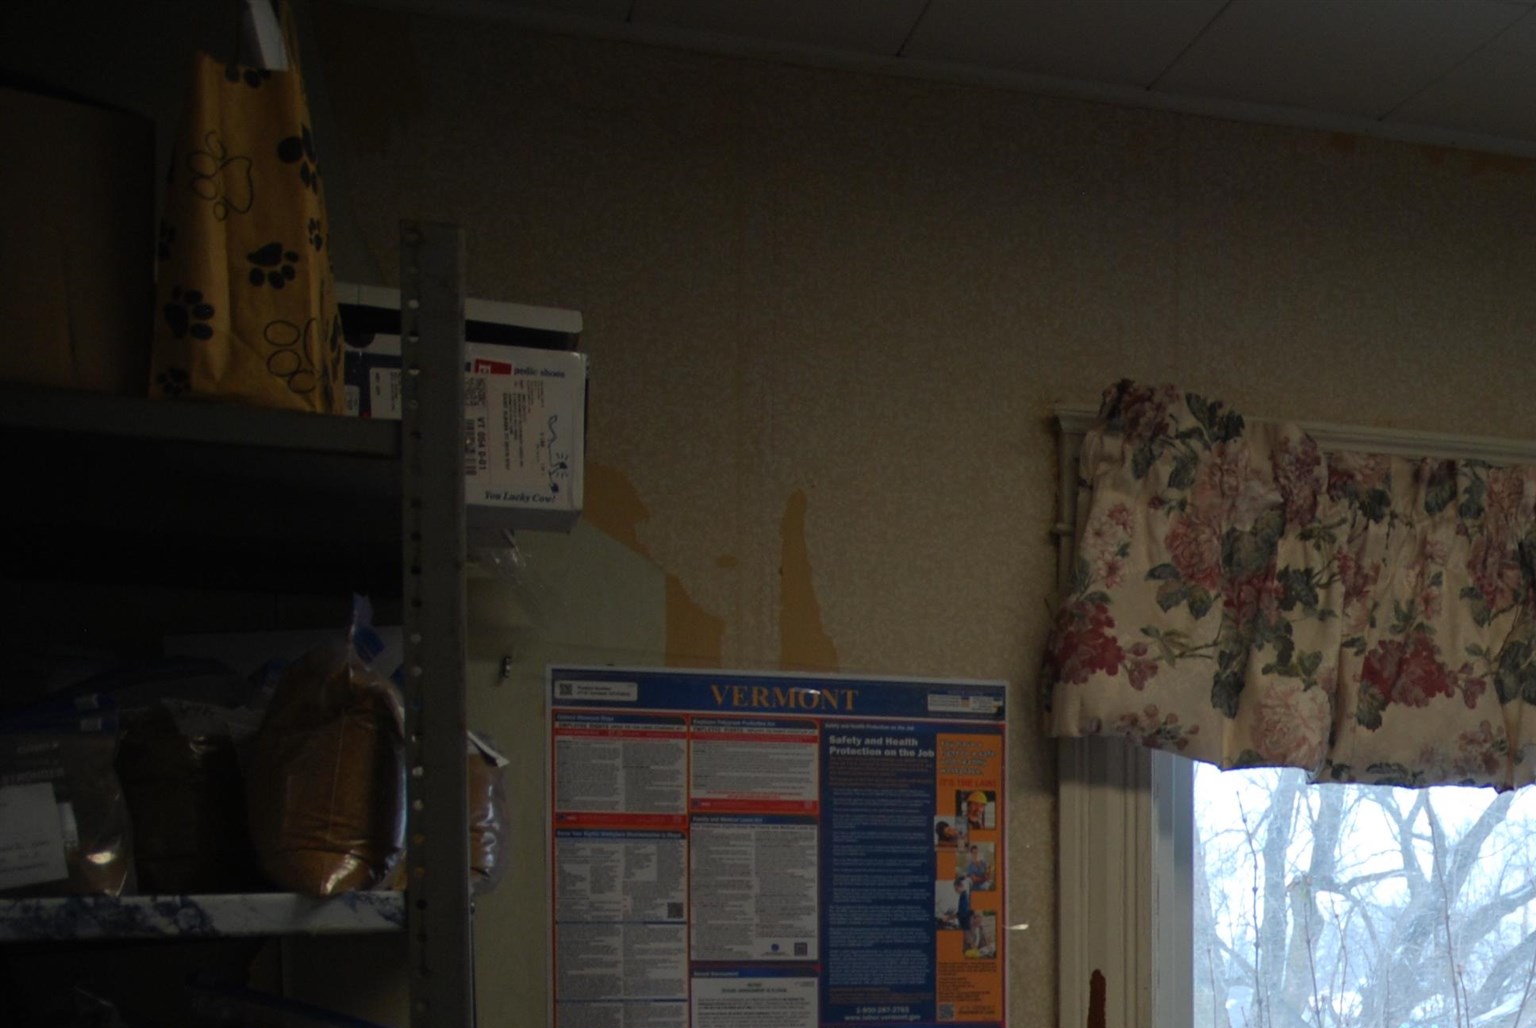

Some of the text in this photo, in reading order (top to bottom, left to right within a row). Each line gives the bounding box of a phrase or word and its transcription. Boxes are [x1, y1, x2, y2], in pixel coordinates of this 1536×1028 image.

[485, 491, 501, 501] You
[503, 492, 530, 503] Lucky
[710, 683, 861, 711] VERMONT
[829, 735, 919, 747] Safety and Health
[829, 745, 935, 758] Protection on the Job
